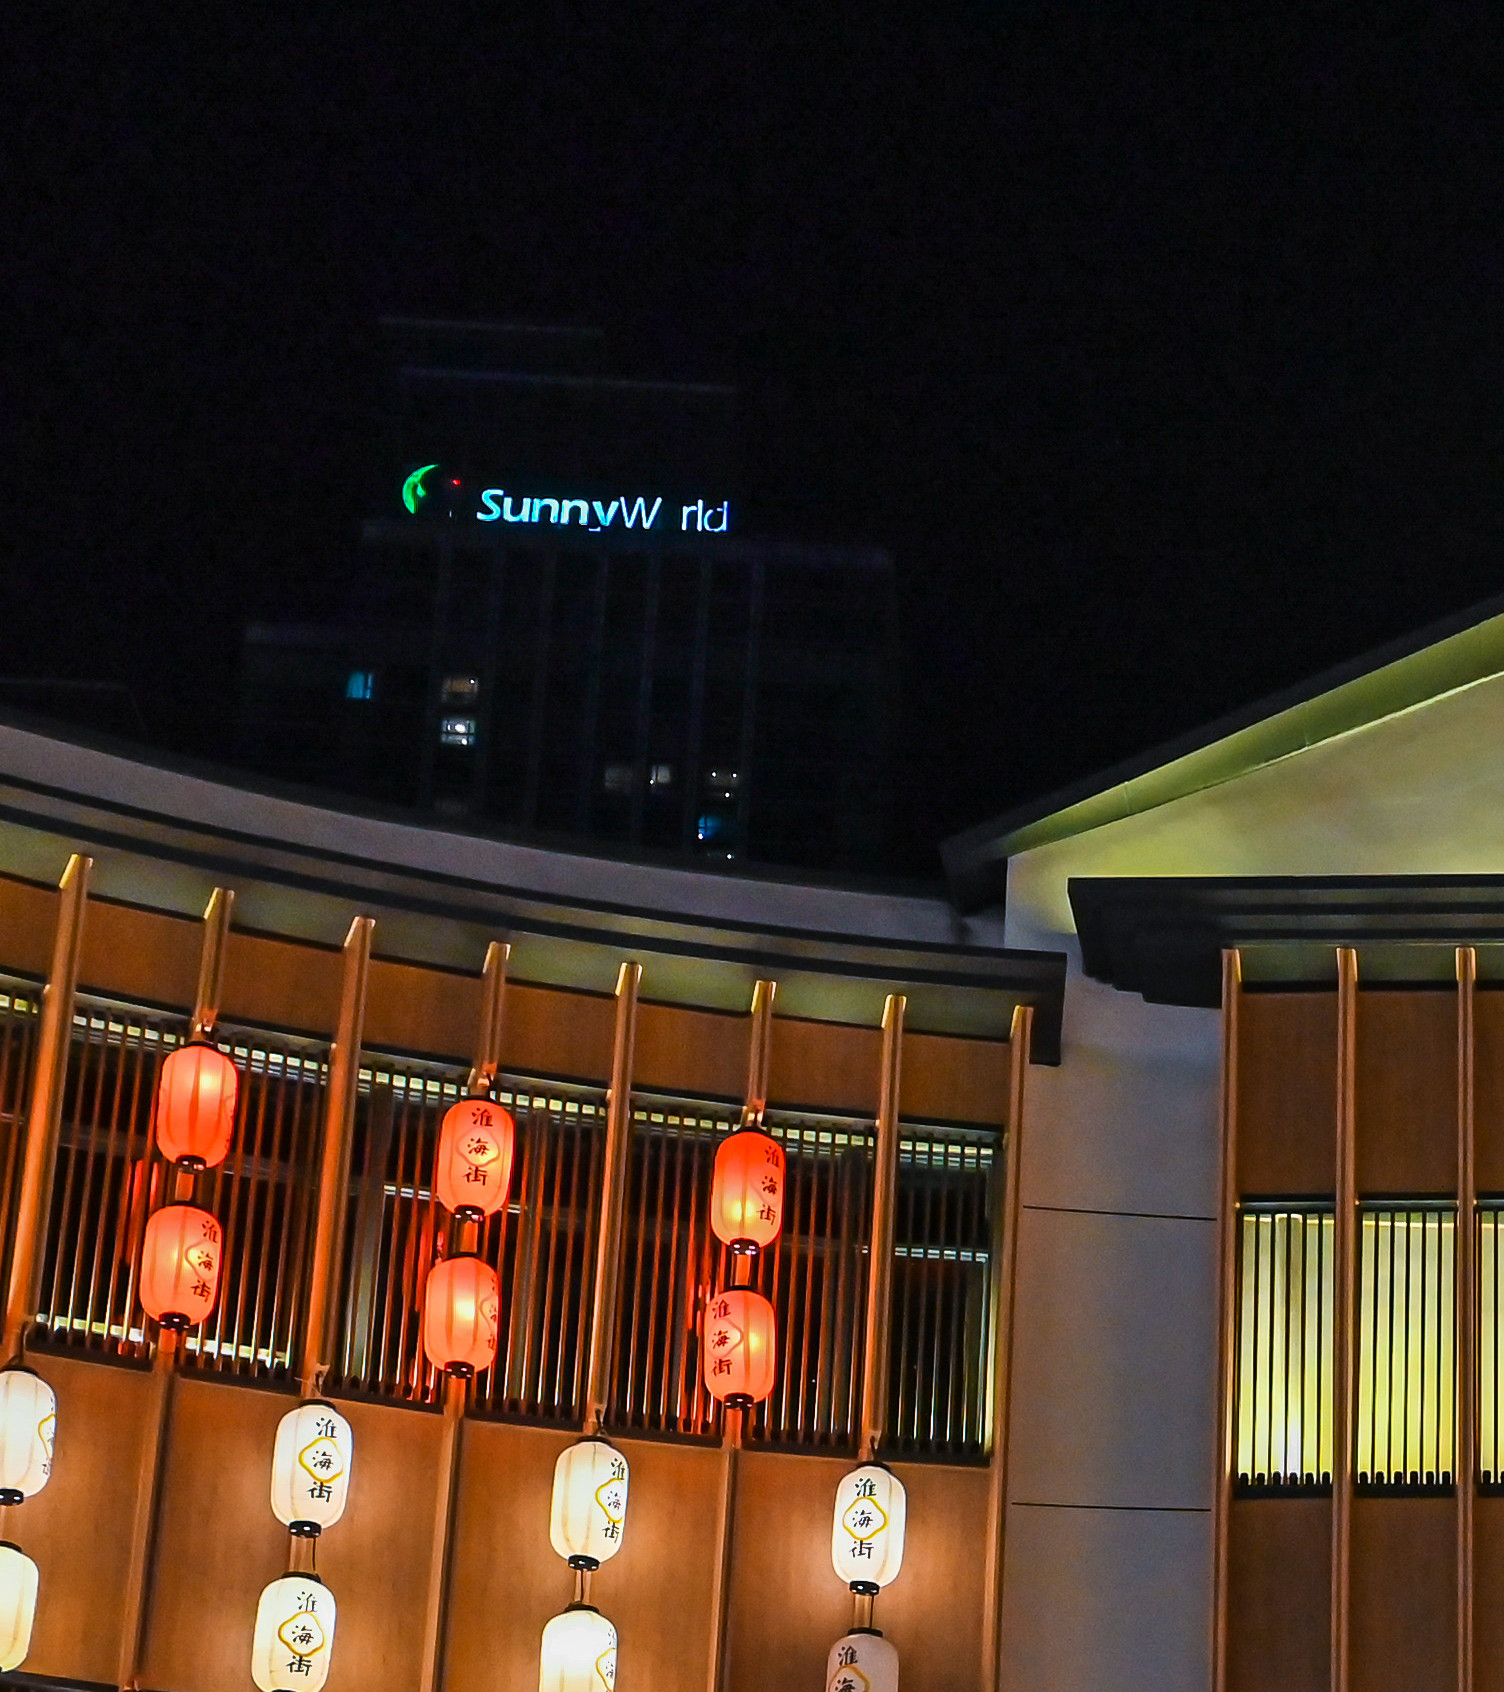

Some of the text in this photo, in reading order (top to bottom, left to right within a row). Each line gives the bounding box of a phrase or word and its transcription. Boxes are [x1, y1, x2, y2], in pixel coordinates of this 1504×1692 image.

[476, 488, 729, 532] SunnyWrld
[462, 1106, 494, 1186] 淮海街
[191, 1220, 217, 1301] 淮海街
[711, 1299, 731, 1378] 淮海街
[307, 1416, 337, 1503] 淮海街
[849, 1477, 877, 1561] 淮海街
[286, 1590, 318, 1676] 淮海街
